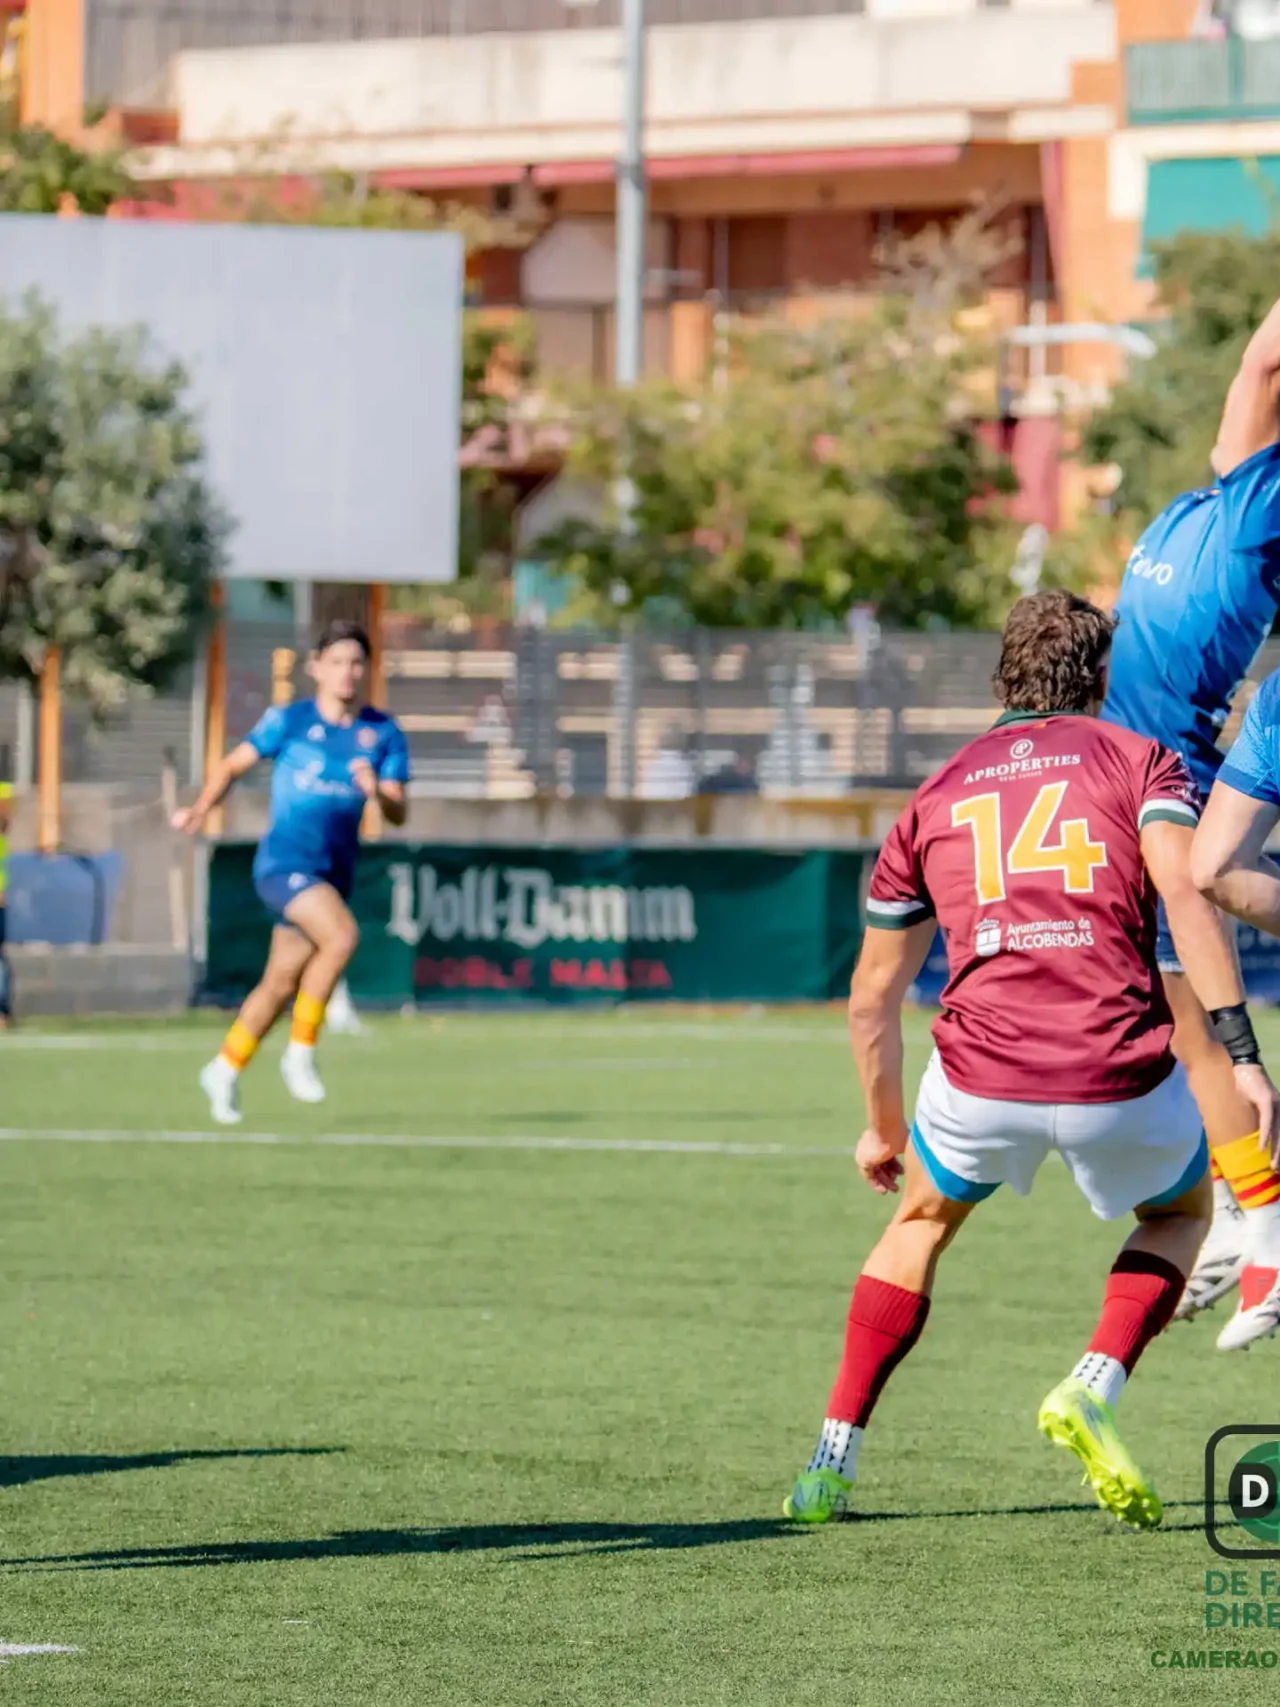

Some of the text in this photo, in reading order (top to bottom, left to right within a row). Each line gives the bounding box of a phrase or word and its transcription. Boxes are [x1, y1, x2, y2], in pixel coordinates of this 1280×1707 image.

[963, 754, 1081, 785] APROPERTIES
[951, 780, 1109, 906] 14
[1007, 919, 1075, 937] Ayuntamiento
[1078, 916, 1091, 930] de
[1007, 931, 1094, 951] ALCOBENDAS
[549, 956, 673, 991] MALTA
